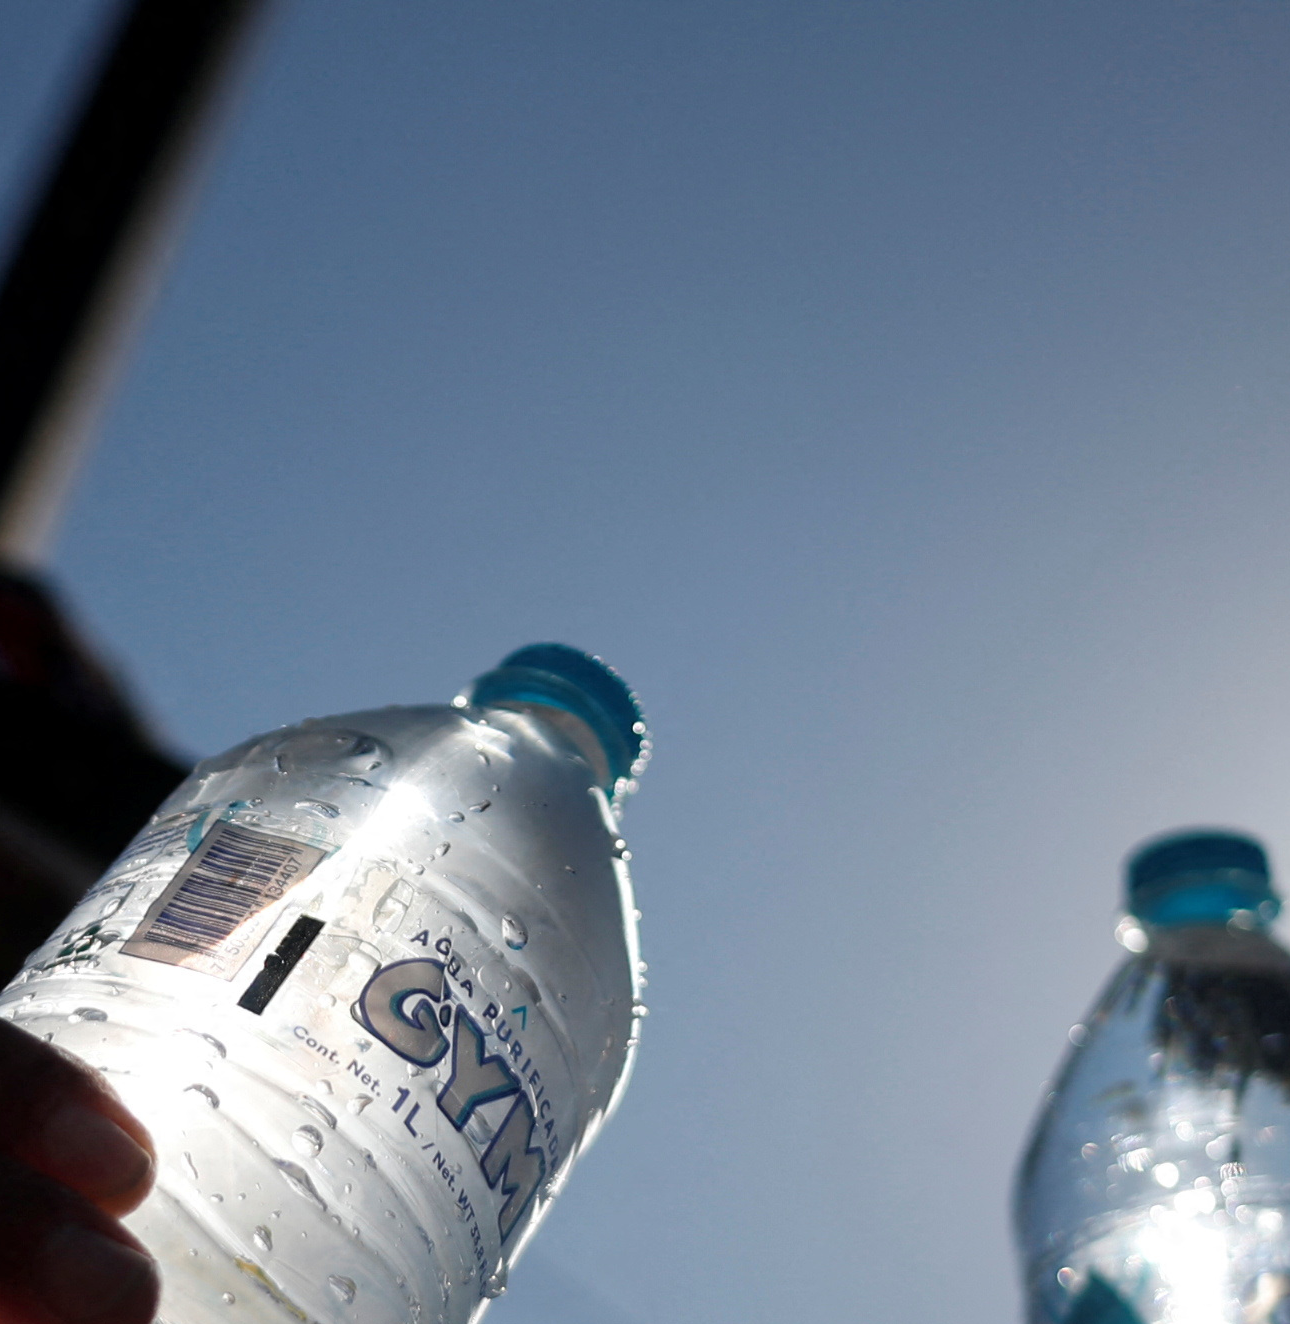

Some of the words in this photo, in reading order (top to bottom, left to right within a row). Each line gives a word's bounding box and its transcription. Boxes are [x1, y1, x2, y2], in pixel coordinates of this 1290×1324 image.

[411, 929, 473, 998] AGUA
[293, 1025, 340, 1064] Cont.
[346, 1058, 382, 1097] Net.
[432, 1151, 457, 1192] Net.
[359, 957, 546, 1246] GYM
